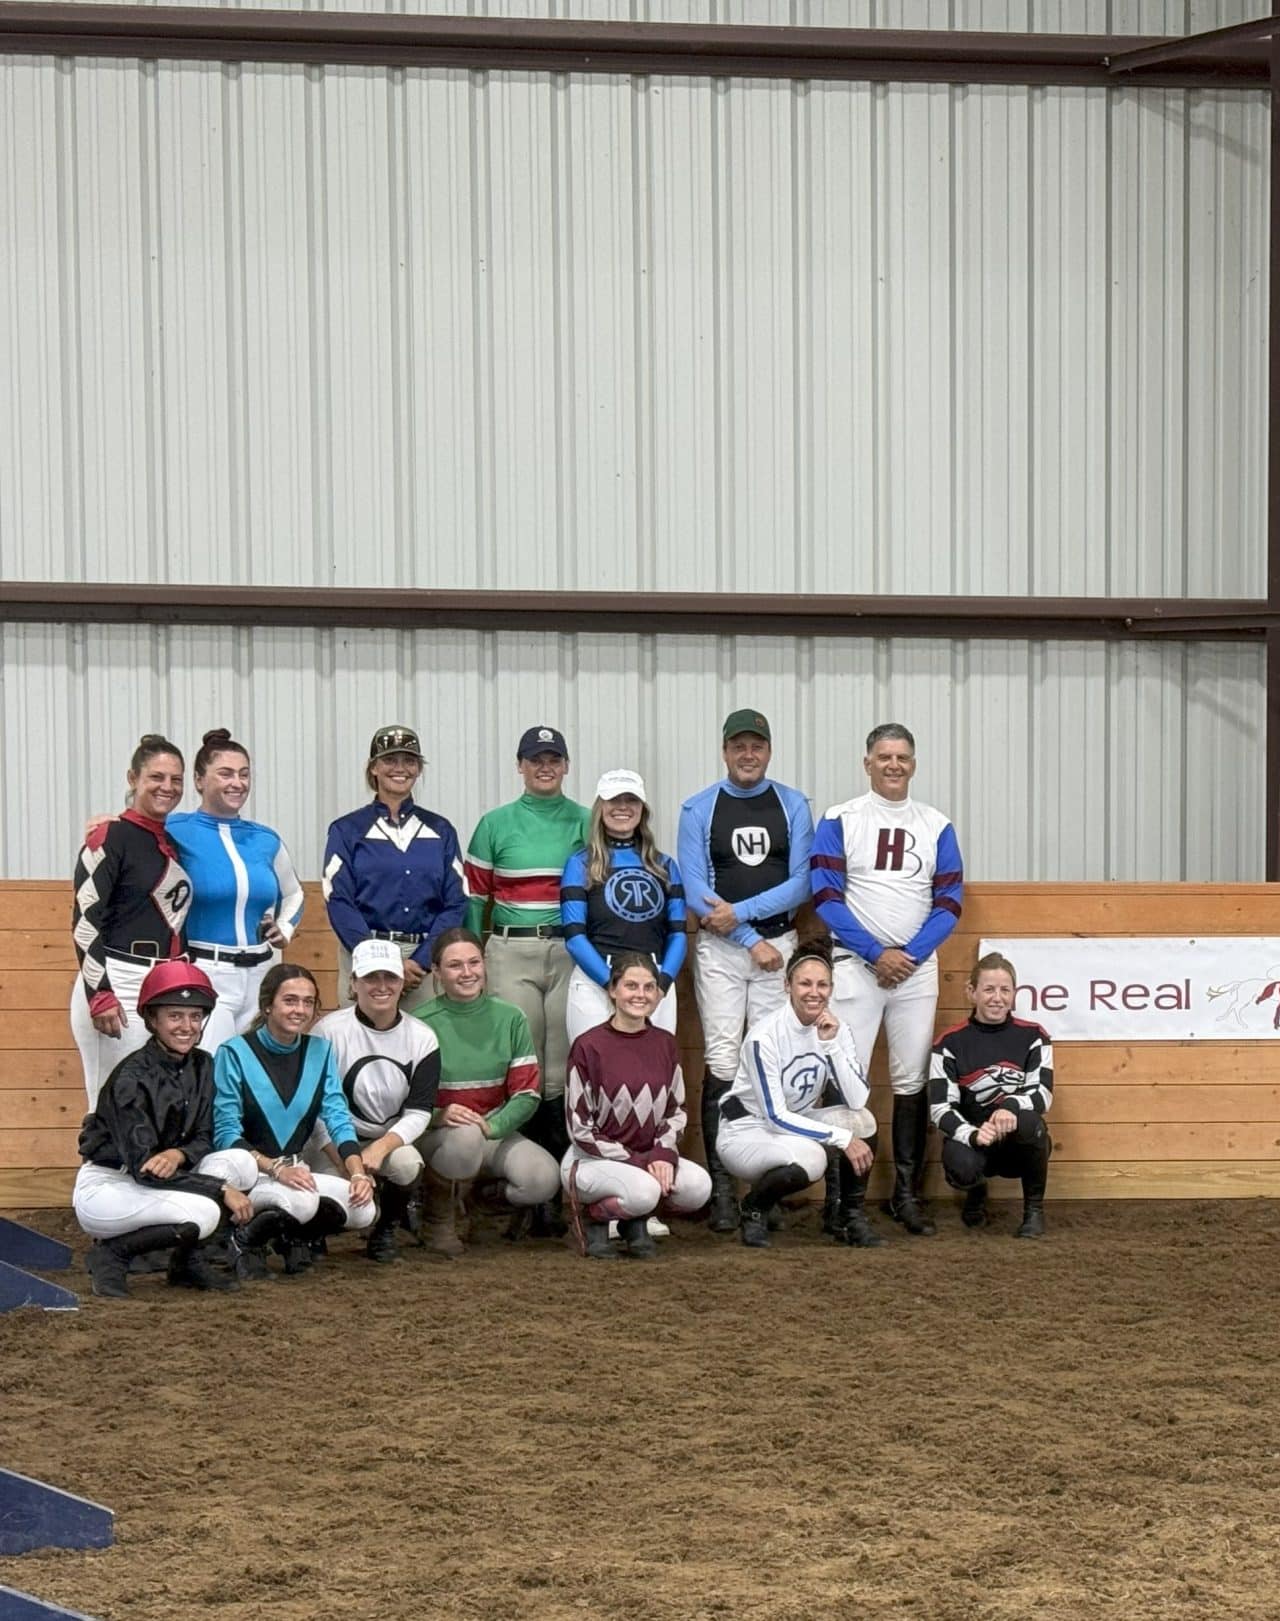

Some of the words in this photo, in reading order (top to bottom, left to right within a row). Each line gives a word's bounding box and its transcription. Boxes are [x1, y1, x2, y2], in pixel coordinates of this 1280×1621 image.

[737, 833, 765, 856] NH
[875, 829, 922, 879] HB
[1090, 978, 1192, 1011] Real
[343, 1055, 413, 1124] C
[791, 1064, 819, 1104] F
